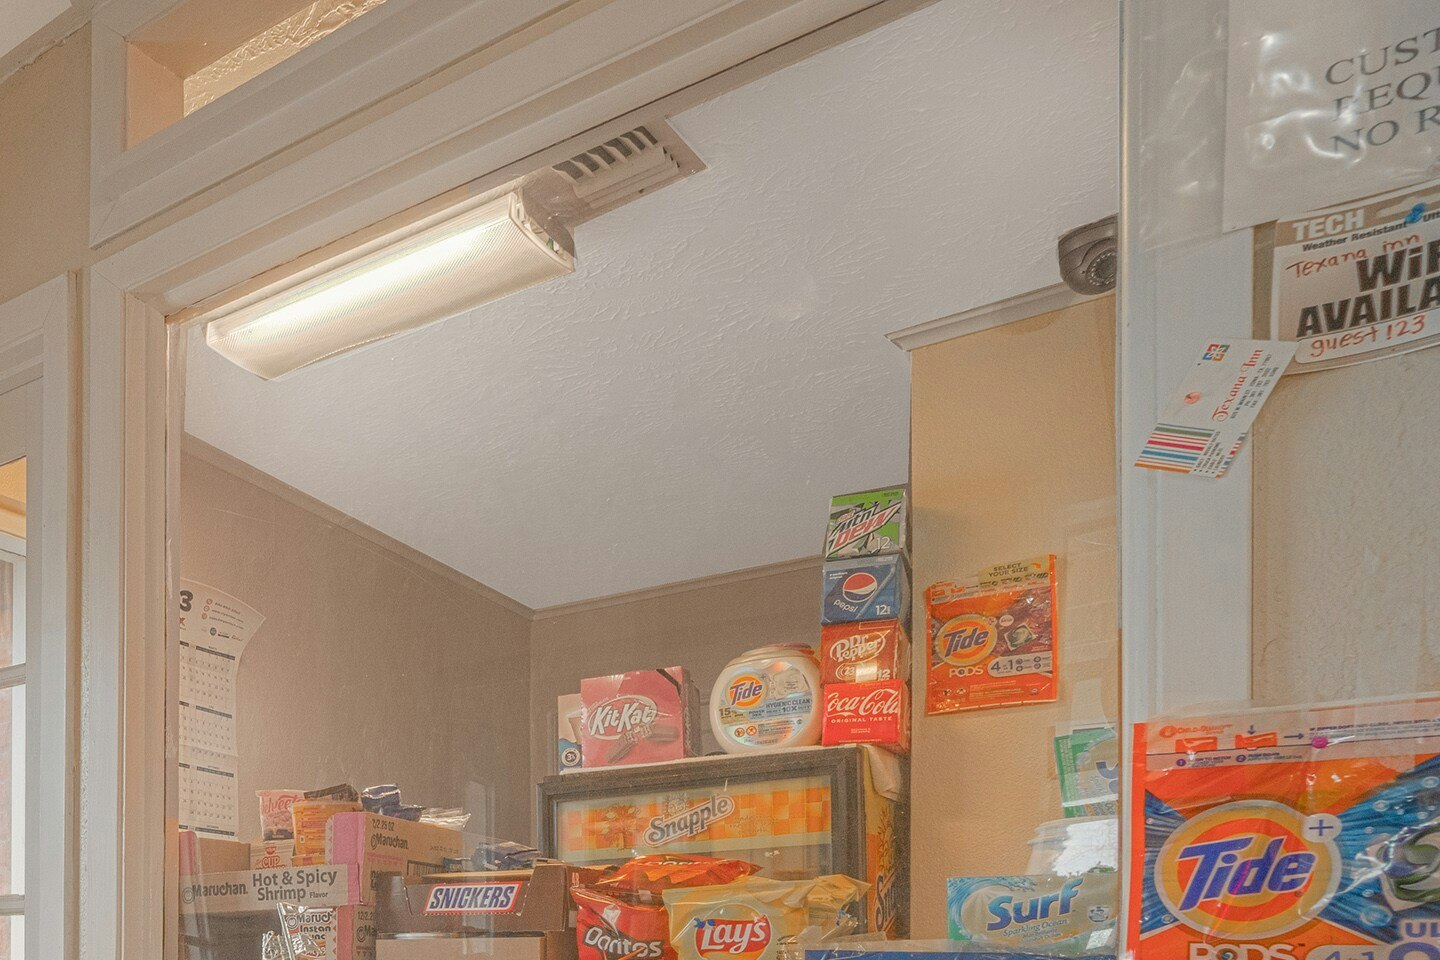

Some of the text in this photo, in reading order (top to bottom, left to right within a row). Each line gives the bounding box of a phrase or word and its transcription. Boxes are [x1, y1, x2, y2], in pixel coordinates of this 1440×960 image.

[1329, 120, 1400, 152] NO
[1292, 208, 1365, 241] TECH
[1302, 236, 1348, 252] Weather
[1286, 249, 1368, 278] Texana
[1310, 326, 1380, 358] guest
[1211, 376, 1248, 422] Texana
[993, 562, 1022, 572] SELECT
[833, 599, 859, 613] pepsi
[944, 627, 990, 658] Tide
[949, 666, 984, 678] PODS
[730, 681, 763, 706] Tide
[648, 795, 729, 842] Snapple
[377, 833, 409, 849] Maruchan
[263, 856, 280, 867] CUP
[1177, 836, 1317, 912] Tide
[192, 882, 248, 897] Maruchan
[253, 869, 338, 887] Hot & Spicy
[257, 886, 306, 902] Shrimp
[429, 885, 516, 909] SNICKERS
[987, 877, 1084, 931] Surf
[1042, 919, 1068, 928] Ocean
[585, 926, 662, 957] Doritos
[701, 919, 767, 954] Lay's
